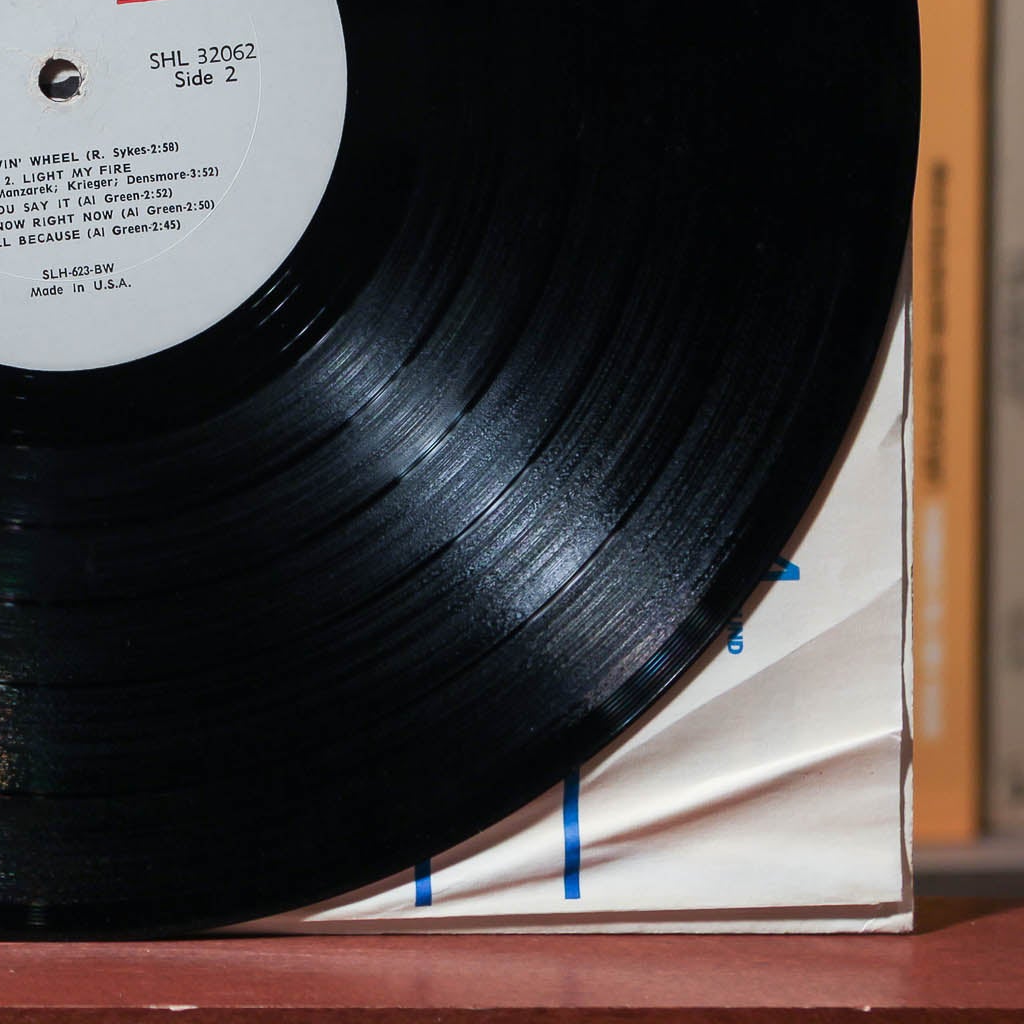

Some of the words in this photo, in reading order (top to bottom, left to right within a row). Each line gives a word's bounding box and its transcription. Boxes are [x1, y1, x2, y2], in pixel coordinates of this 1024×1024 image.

[149, 48, 189, 70] SHL
[197, 43, 258, 65] 32062
[174, 70, 214, 88] Side
[225, 66, 238, 83] 2
[30, 152, 79, 167] WHEEL
[86, 150, 105, 162] (R.
[113, 141, 179, 159] Sykes-2:58)
[4, 176, 15, 185] 2.
[23, 170, 64, 184] LIGHT
[71, 167, 93, 178] MY
[99, 163, 132, 175] FIRE
[67, 178, 118, 191] Krieger;
[127, 167, 219, 185] Densmore-3:52)
[24, 201, 49, 212] SAY
[58, 198, 70, 208] IT
[78, 195, 96, 207] (Al
[104, 188, 173, 204] Green-2:52)
[32, 214, 74, 227] RIGHT
[83, 210, 114, 222] NOW
[121, 207, 139, 219] (Al
[147, 200, 215, 216] Green-2:50)
[19, 230, 80, 246] BECAUSE
[87, 227, 105, 239] (Al
[112, 219, 181, 236] Green-2:45)
[42, 263, 114, 280] SLH-623-BW
[30, 284, 64, 298] Made
[94, 277, 132, 291] U.S.A.
